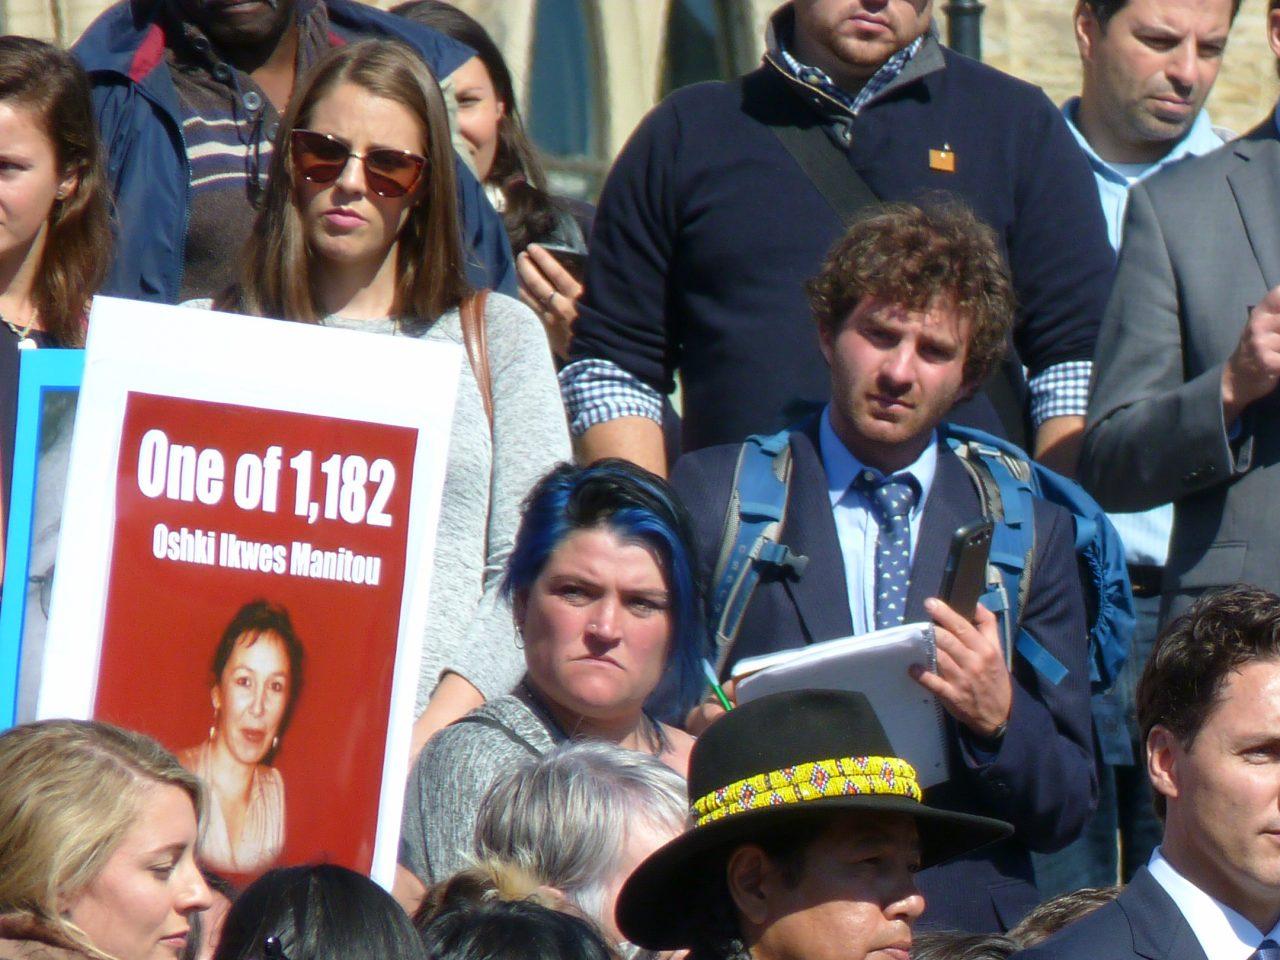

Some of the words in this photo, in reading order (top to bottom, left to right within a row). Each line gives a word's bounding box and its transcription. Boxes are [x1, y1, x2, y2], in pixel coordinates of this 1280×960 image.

[137, 428, 225, 505] One
[234, 446, 282, 513] of
[290, 450, 396, 527] 1,182
[153, 523, 216, 565] Oshki
[220, 532, 286, 574] Ikwes
[290, 541, 381, 586] Manitou
